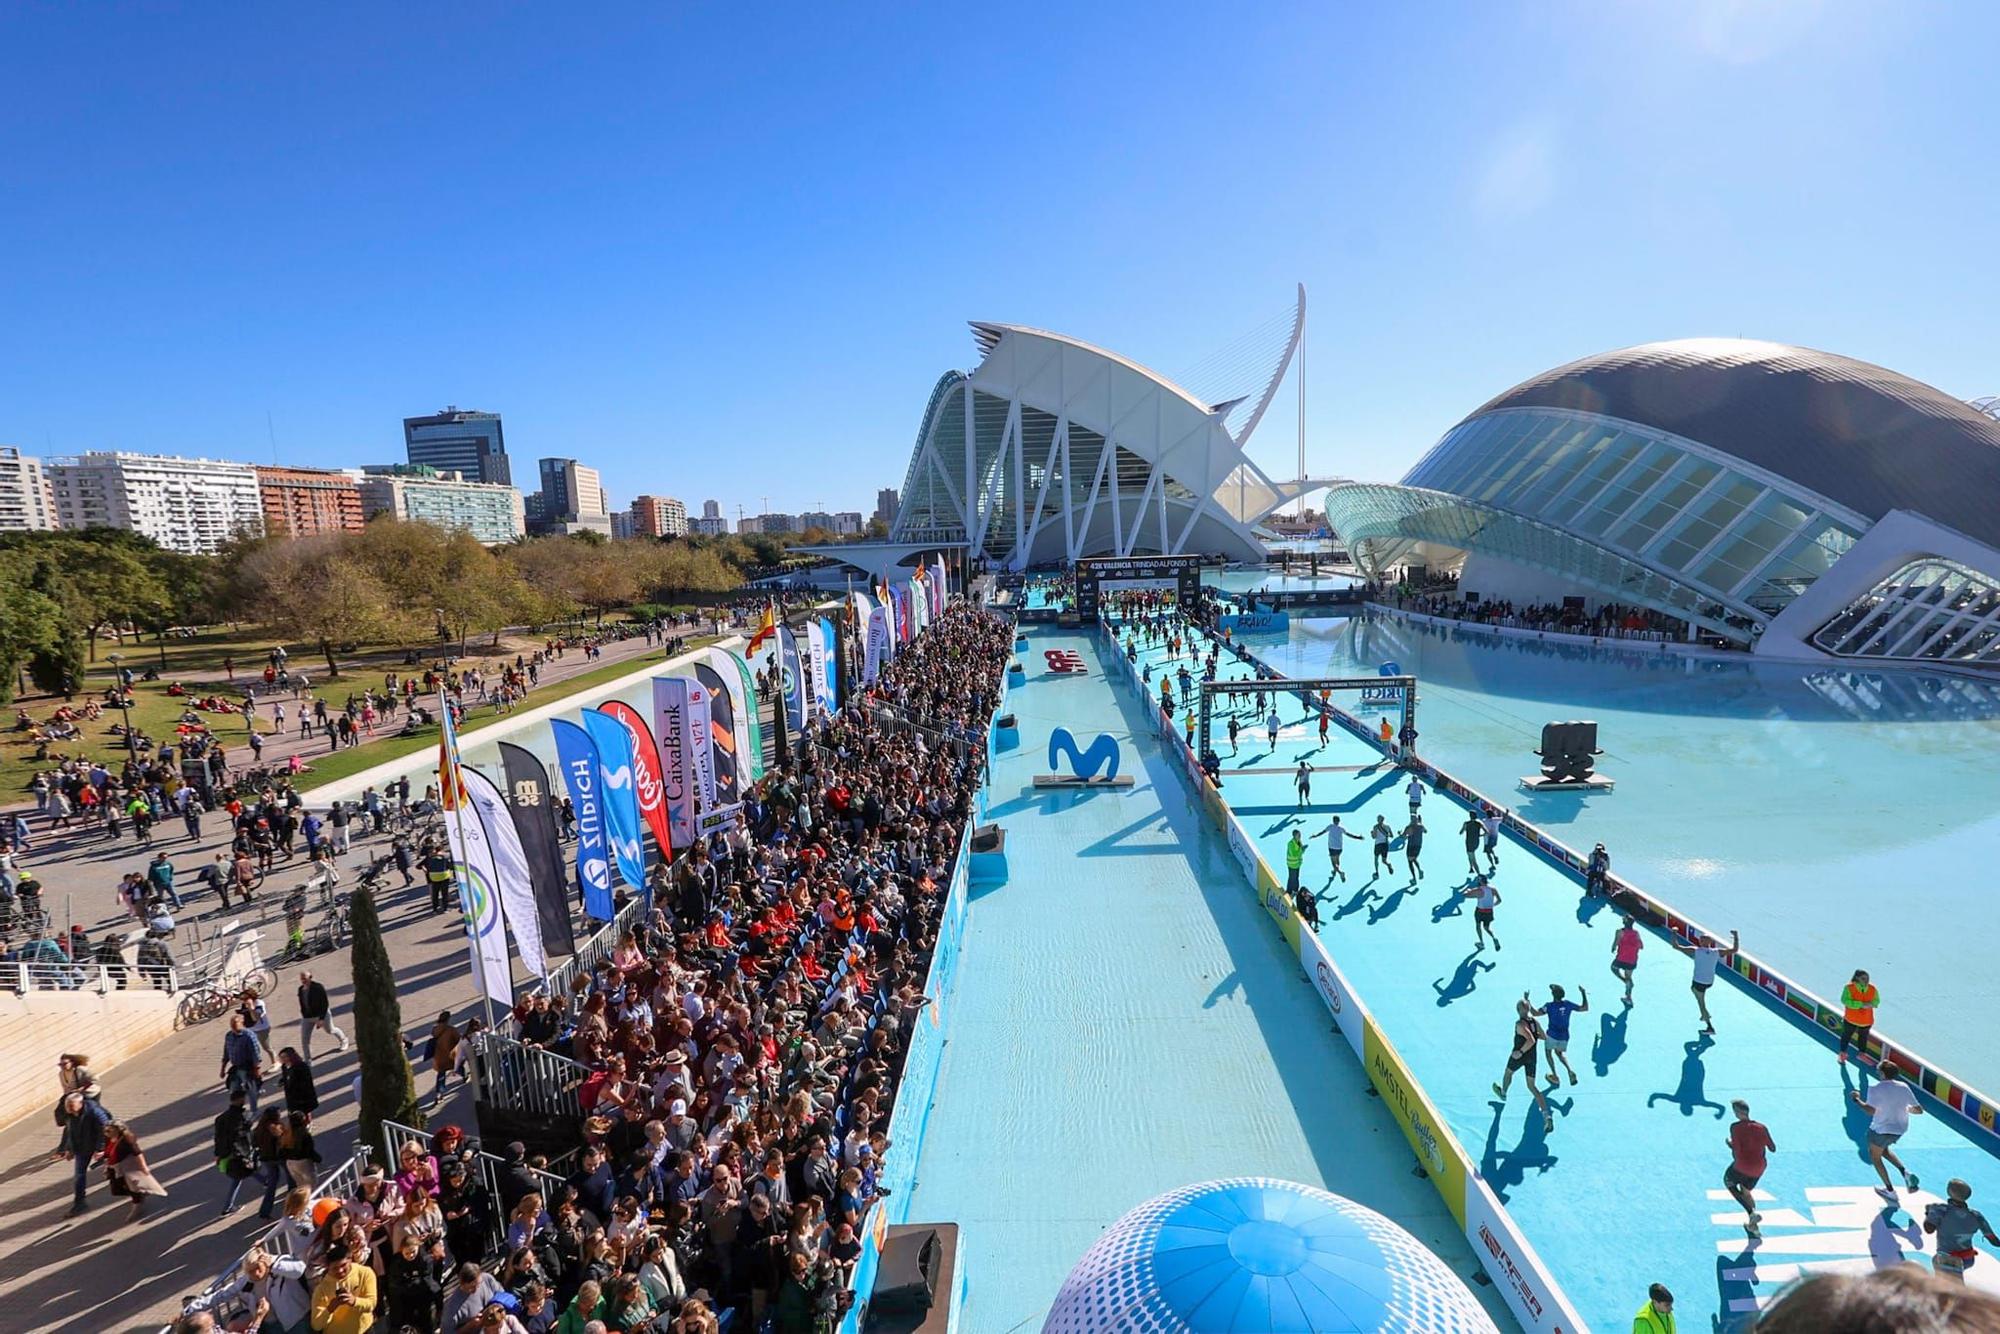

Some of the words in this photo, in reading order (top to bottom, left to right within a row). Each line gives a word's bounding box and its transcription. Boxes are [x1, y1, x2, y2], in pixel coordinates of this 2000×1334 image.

[1103, 561, 1132, 569] VALENCIA
[1159, 559, 1187, 567] ALFONSO
[663, 704, 684, 801] CaixaBank
[1374, 1054, 1411, 1120] AMSTEL
